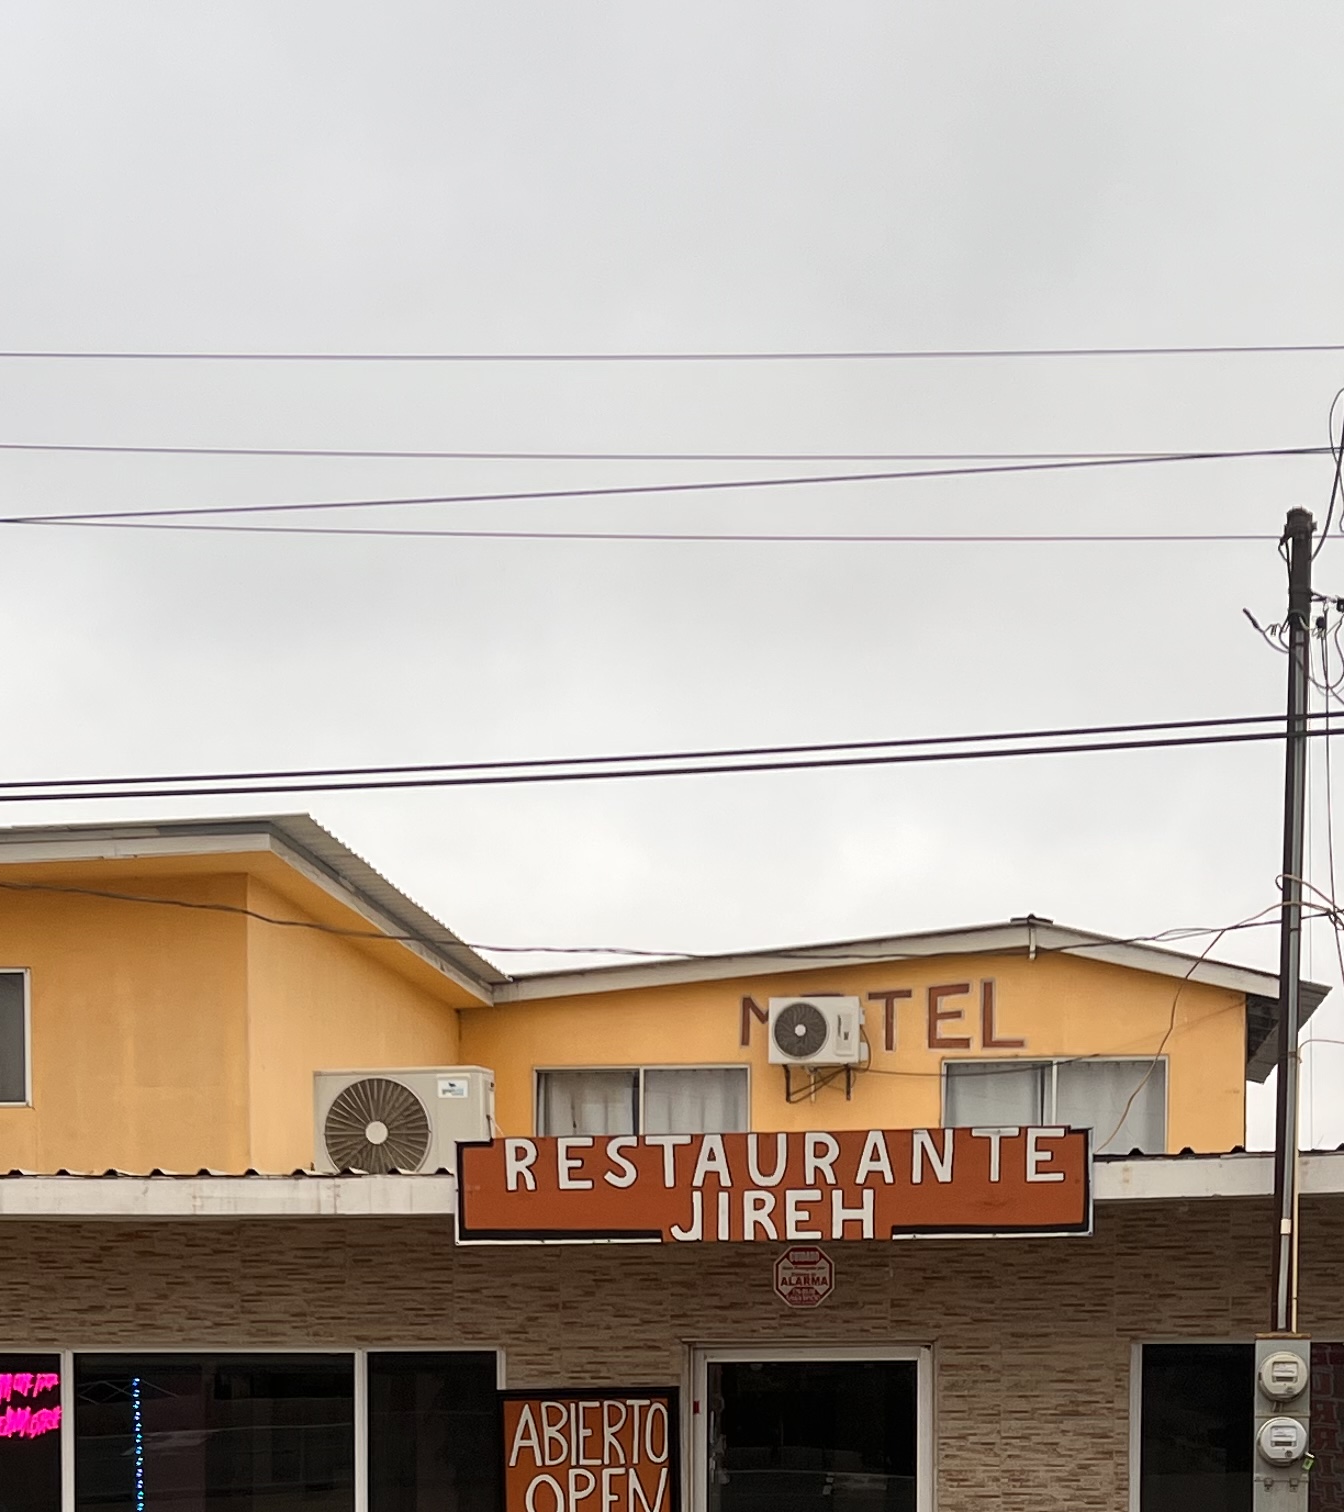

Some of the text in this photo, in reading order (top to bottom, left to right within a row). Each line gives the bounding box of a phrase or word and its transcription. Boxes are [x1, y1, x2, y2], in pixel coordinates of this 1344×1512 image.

[740, 980, 1026, 1051] MTEL
[504, 1127, 1066, 1191] RESTAURANTE
[669, 1188, 875, 1242] JIREH
[780, 1276, 828, 1286] ALARMA
[509, 1400, 669, 1466] ABIERTO
